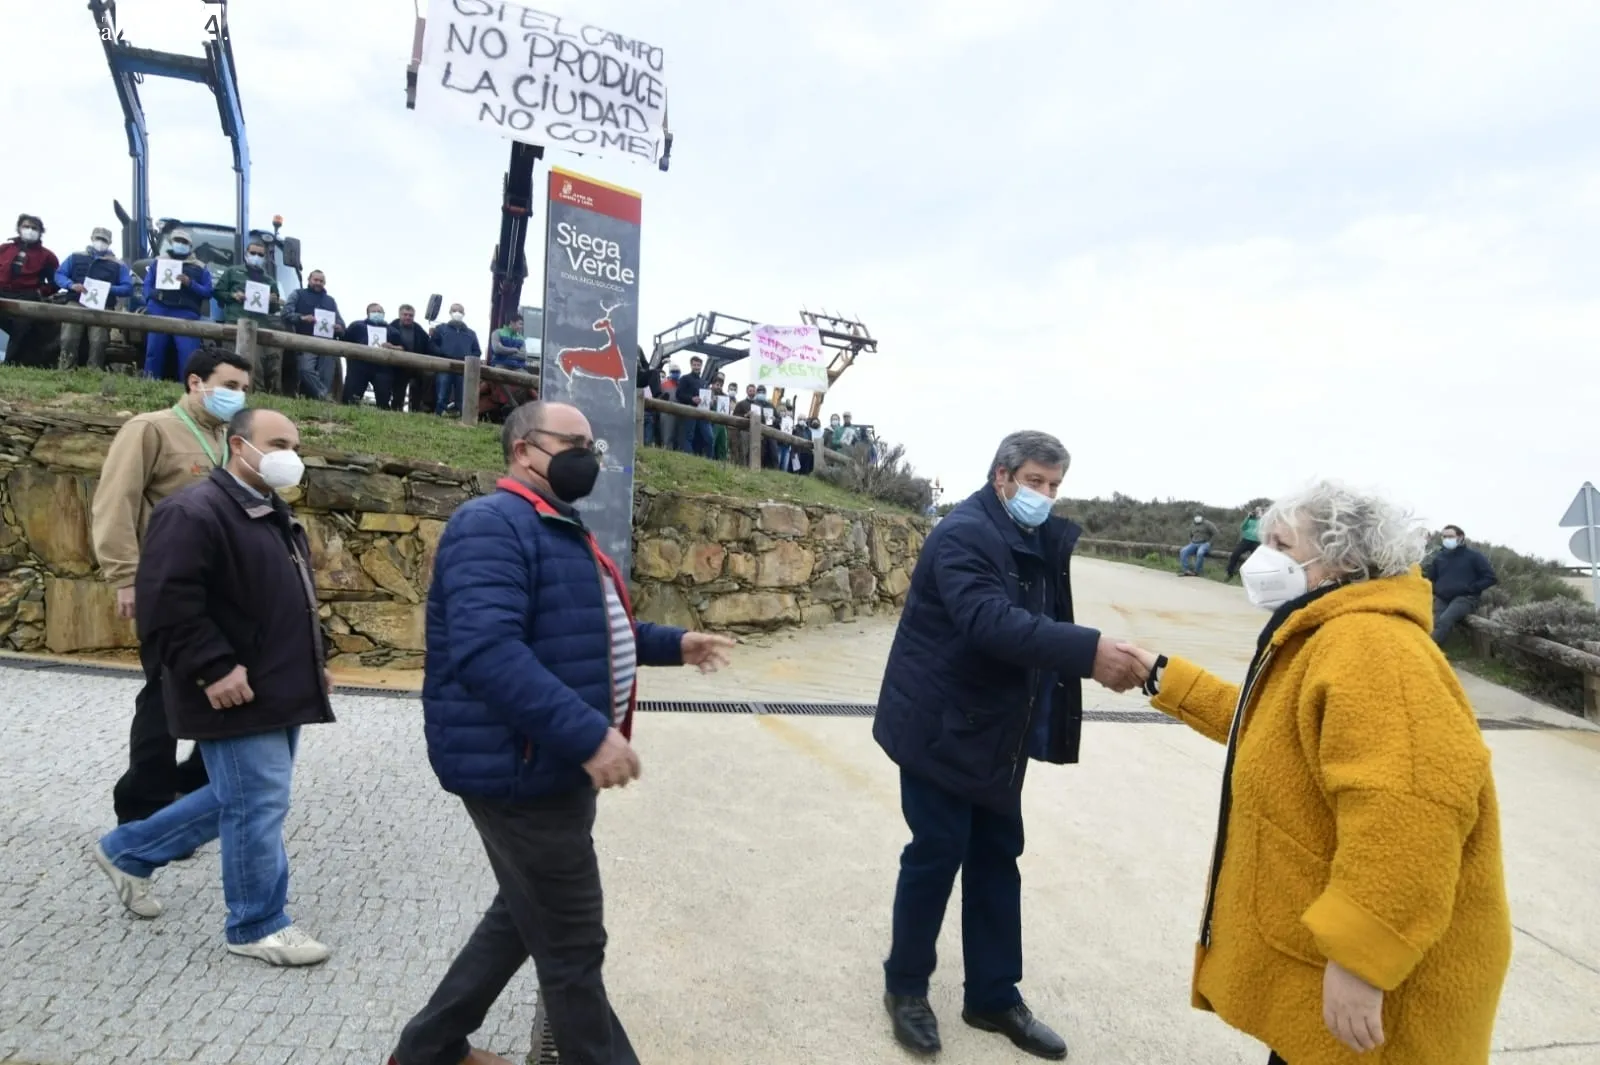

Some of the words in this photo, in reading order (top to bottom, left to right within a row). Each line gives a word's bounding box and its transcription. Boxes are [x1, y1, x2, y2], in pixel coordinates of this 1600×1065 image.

[519, 8, 577, 39] EL
[580, 25, 664, 72] CAMPO
[441, 62, 499, 97] LA
[447, 23, 508, 59] NO
[523, 33, 663, 110] PRODUCE
[478, 102, 535, 130] NO
[557, 222, 621, 260] Siega
[566, 247, 634, 284] Verde
